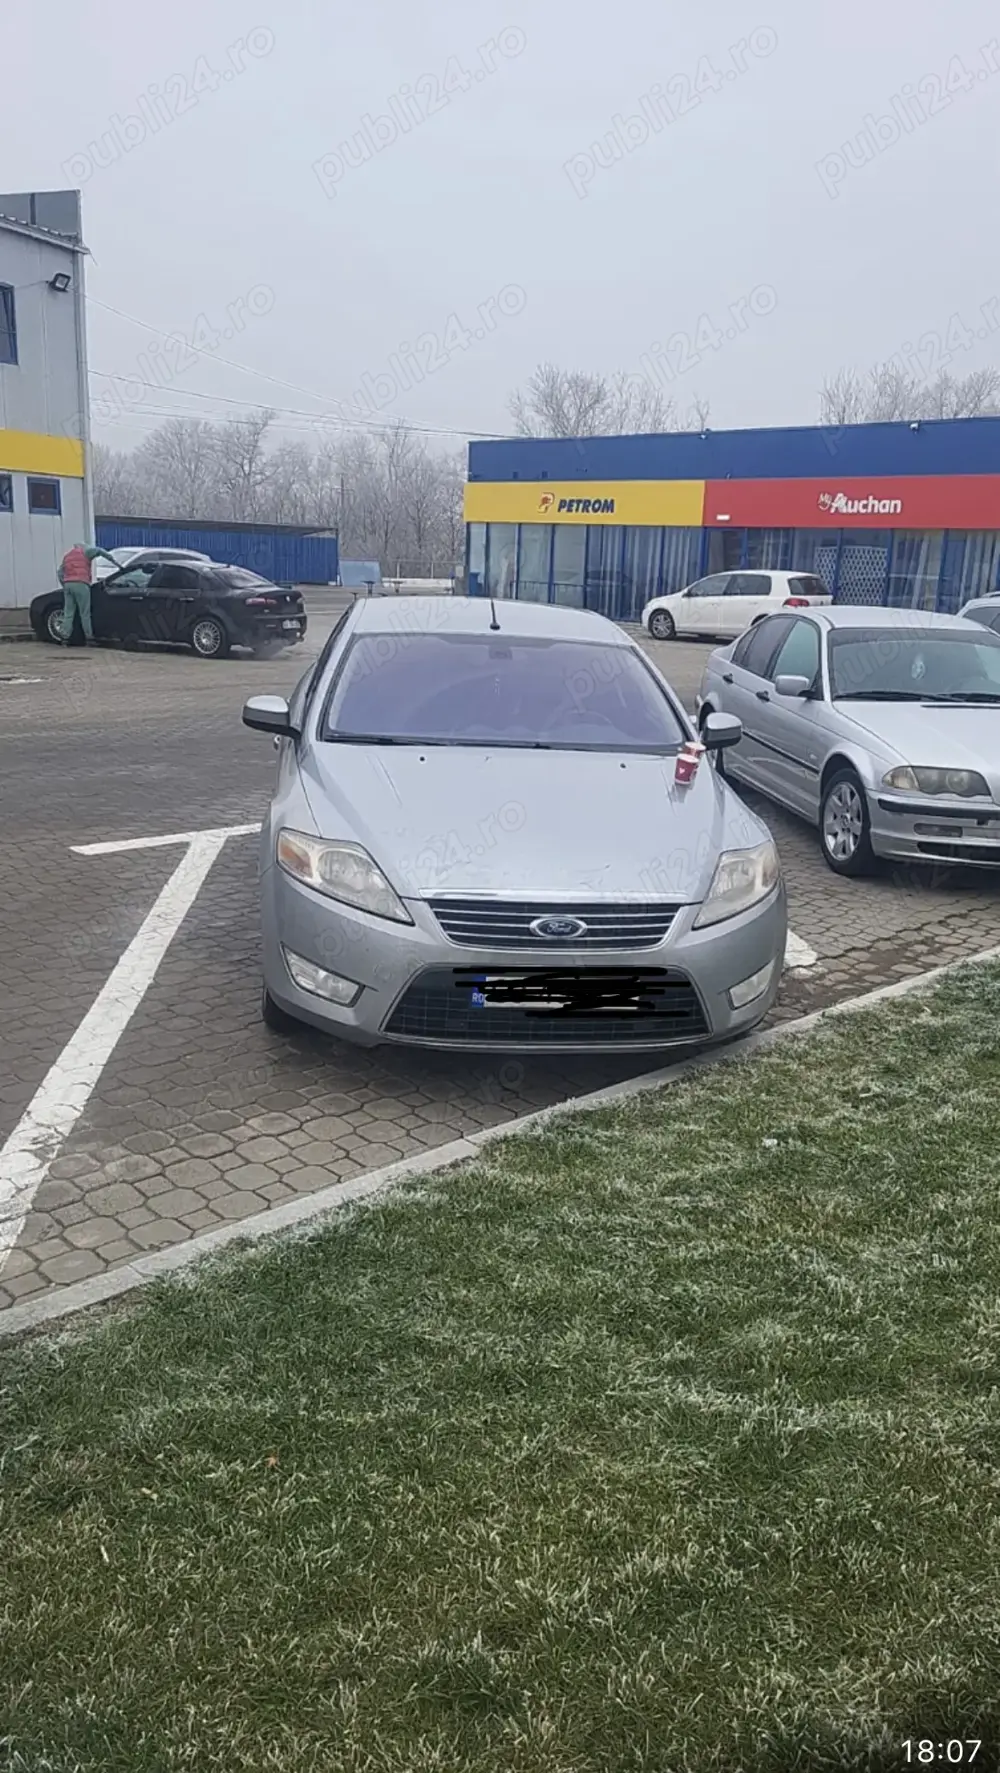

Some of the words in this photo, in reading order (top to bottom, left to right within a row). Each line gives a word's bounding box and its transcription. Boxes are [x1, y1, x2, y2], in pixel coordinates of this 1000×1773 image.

[557, 498, 615, 514] PETROM
[830, 492, 902, 514] Auchan
[547, 922, 572, 933] Ford
